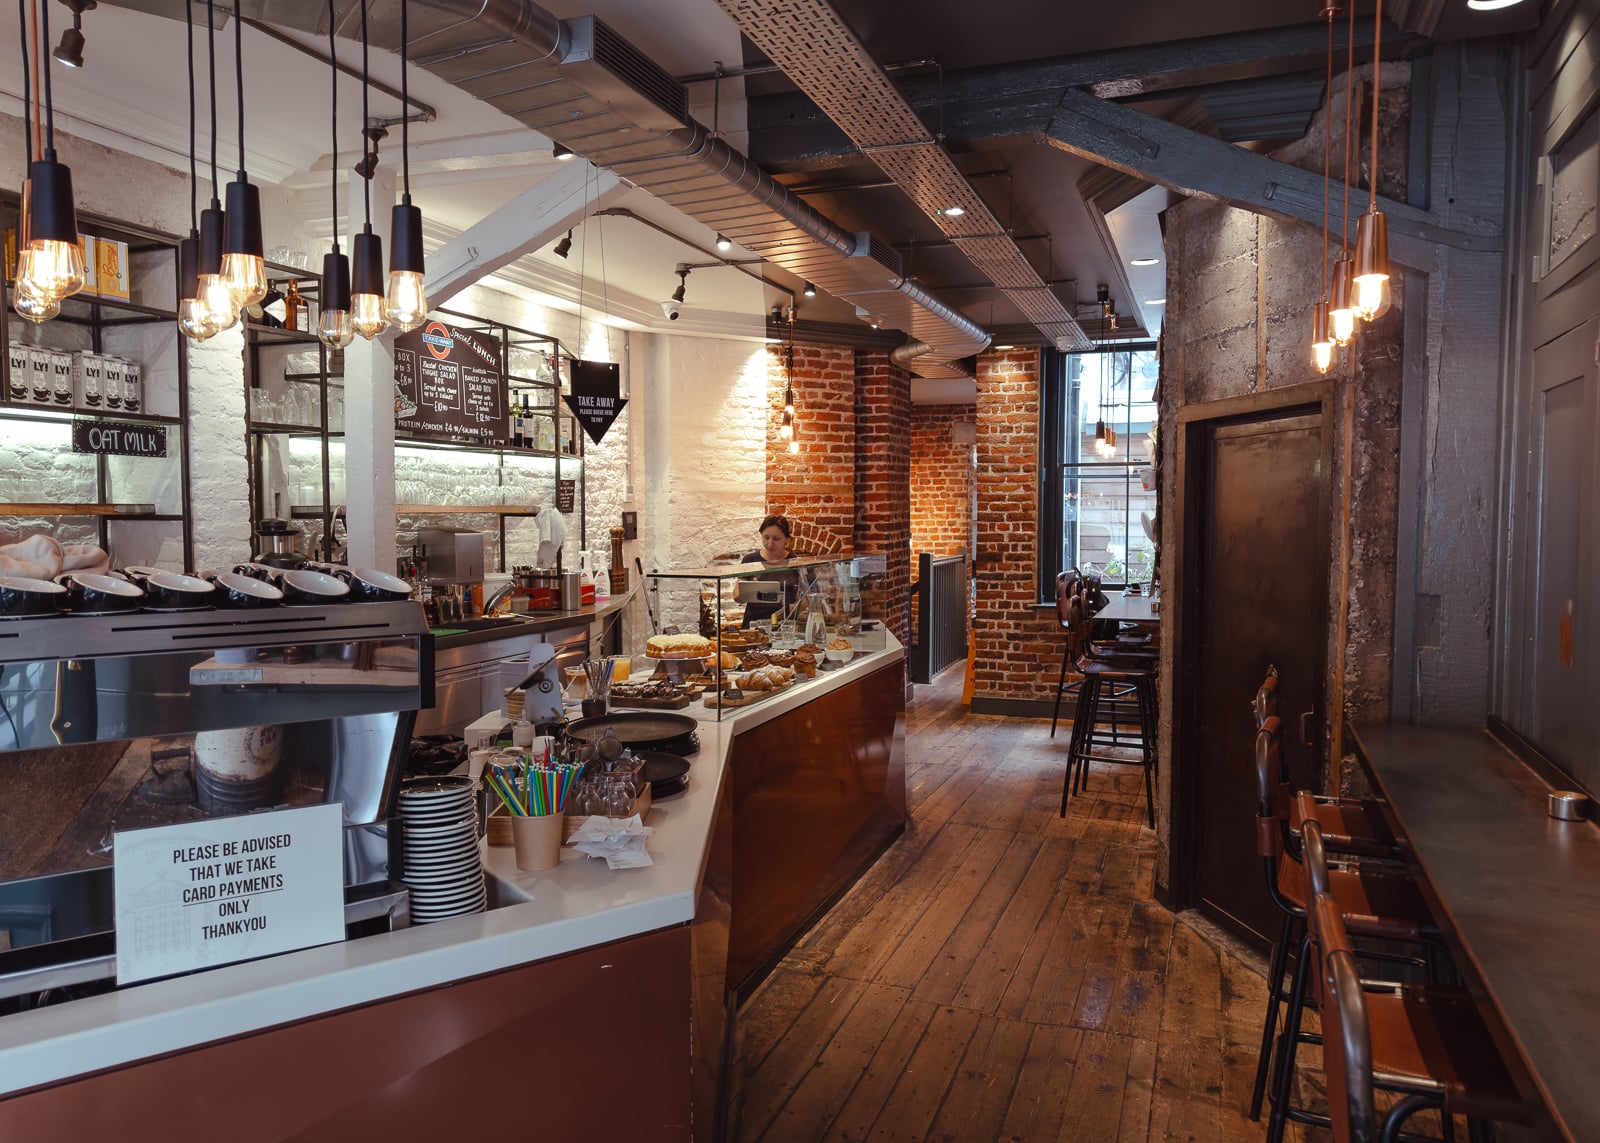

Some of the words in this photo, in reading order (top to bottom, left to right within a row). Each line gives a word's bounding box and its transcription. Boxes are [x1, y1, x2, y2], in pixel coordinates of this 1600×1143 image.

[472, 342, 496, 366] LUNCH
[12, 358, 26, 368] LY!
[34, 362, 48, 372] LY!
[406, 364, 410, 372] 3
[55, 365, 70, 375] LY!
[86, 368, 100, 378] LY!
[107, 370, 120, 380] LY!
[125, 374, 138, 384] LY!
[440, 371, 456, 380] SALAD
[468, 383, 482, 392] SALAD
[578, 396, 594, 406] TAKE
[596, 396, 614, 408] AWAY
[398, 420, 420, 428] PROTEIN
[88, 428, 120, 450] OAT
[124, 432, 156, 452] MILK
[173, 844, 220, 864] PLEASE
[223, 842, 238, 856] BE
[242, 834, 291, 854] ADVISED
[190, 864, 222, 882] THAT
[224, 860, 243, 876] WE
[246, 856, 276, 872] TAKE
[182, 884, 216, 904] CARD
[220, 874, 284, 897] PAYMENTS
[218, 899, 250, 917] ONLY
[202, 916, 267, 940] THANKYOU
